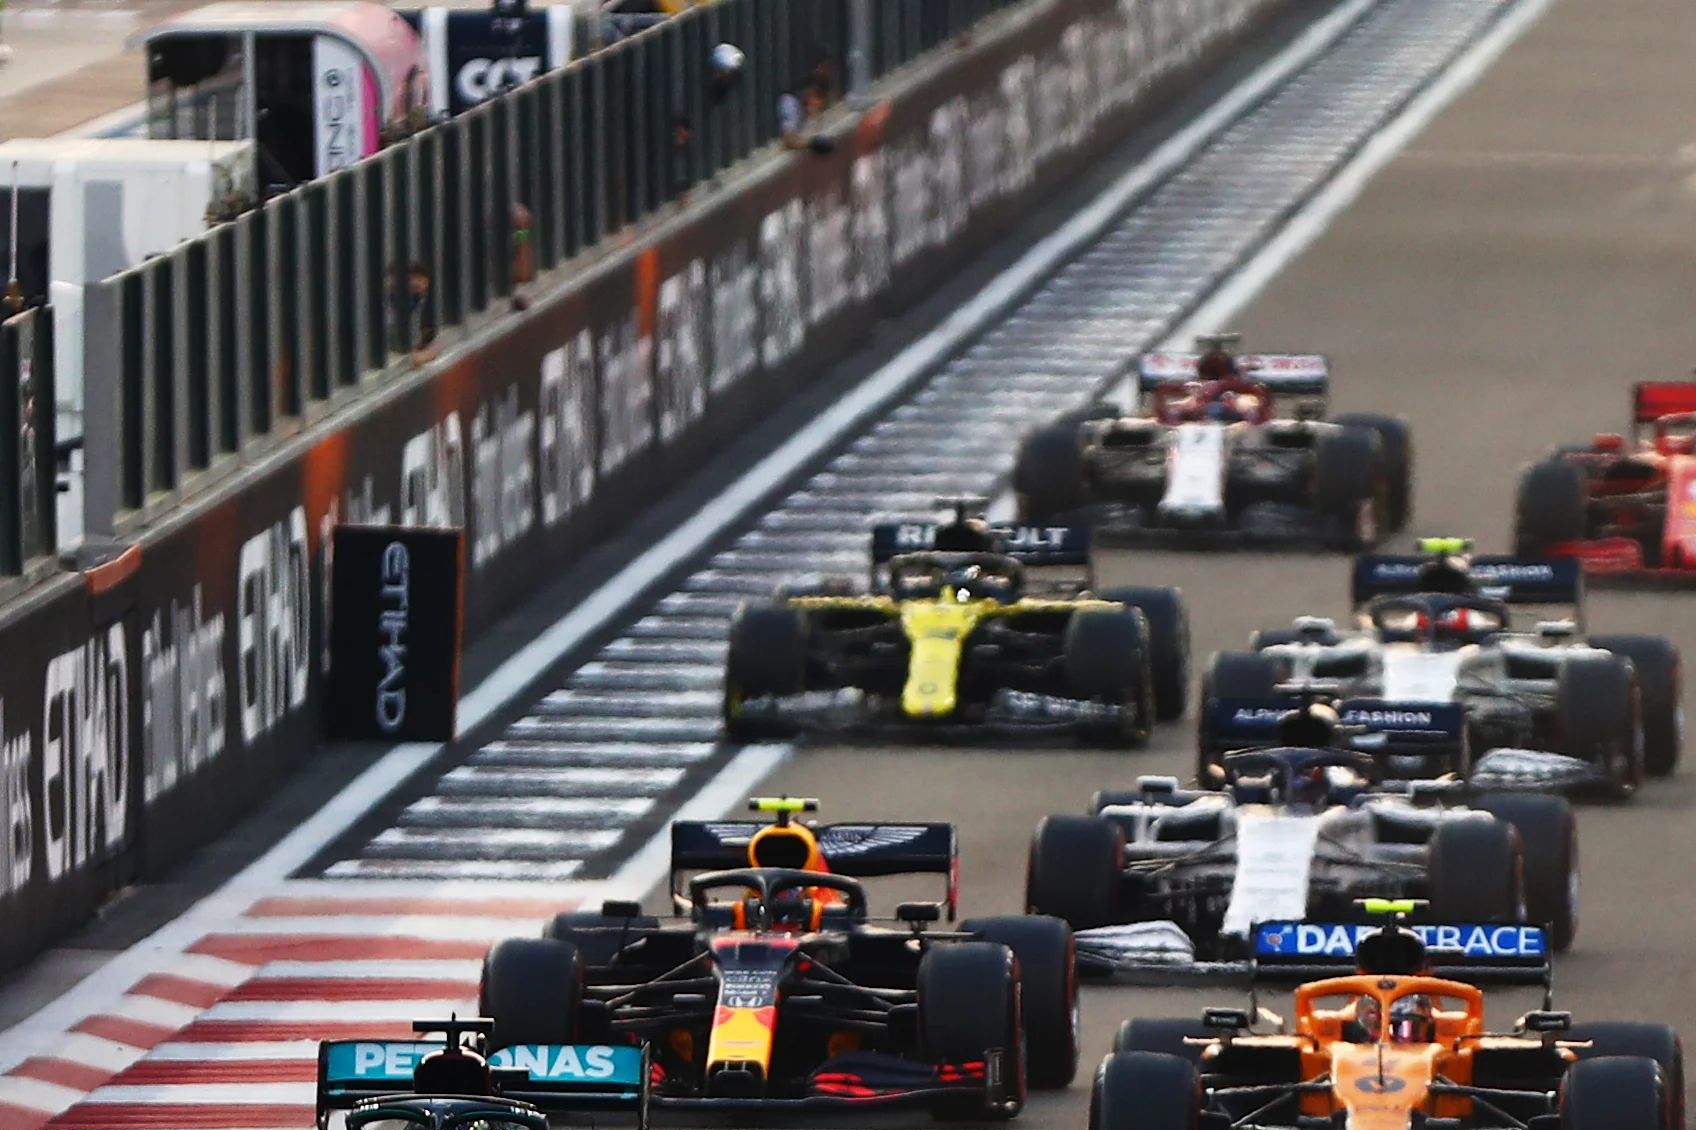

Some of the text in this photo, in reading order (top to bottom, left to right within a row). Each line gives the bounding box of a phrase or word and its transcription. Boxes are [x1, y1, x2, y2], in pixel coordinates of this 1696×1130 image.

[376, 540, 410, 731] ETIHAD
[43, 621, 129, 883] ETIHAD
[1296, 924, 1543, 955] DATRACE
